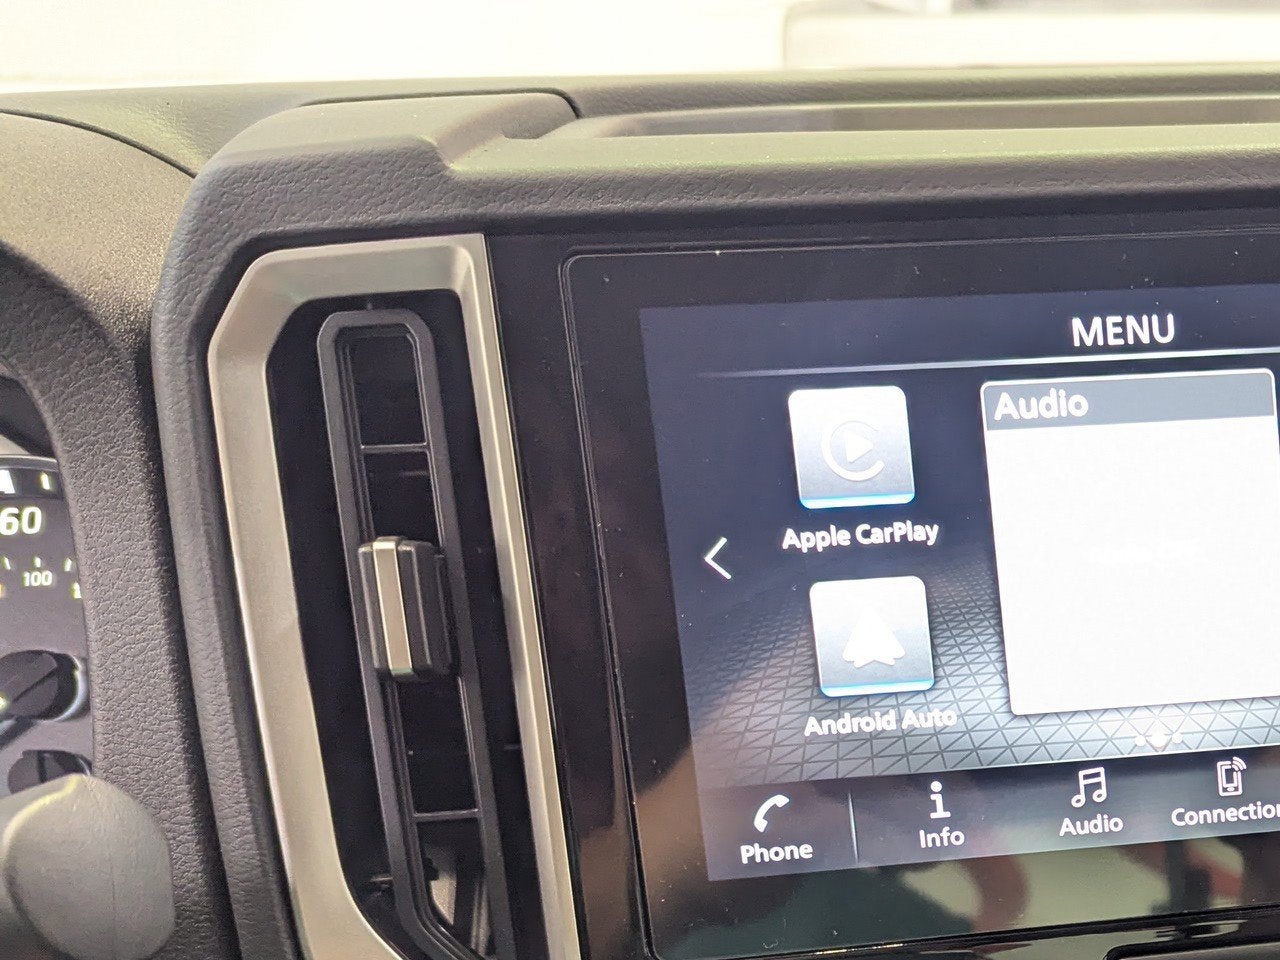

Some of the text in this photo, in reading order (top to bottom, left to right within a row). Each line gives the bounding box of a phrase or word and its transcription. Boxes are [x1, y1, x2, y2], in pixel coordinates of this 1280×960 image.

[1071, 312, 1176, 347] MENU
[993, 388, 1089, 421] Audio
[782, 519, 939, 553] Apple CarPlay
[23, 569, 53, 587] 100
[804, 707, 958, 736] Android Auto
[919, 827, 965, 849] Info
[1059, 812, 1124, 837] Audio
[740, 842, 813, 864] Phone
